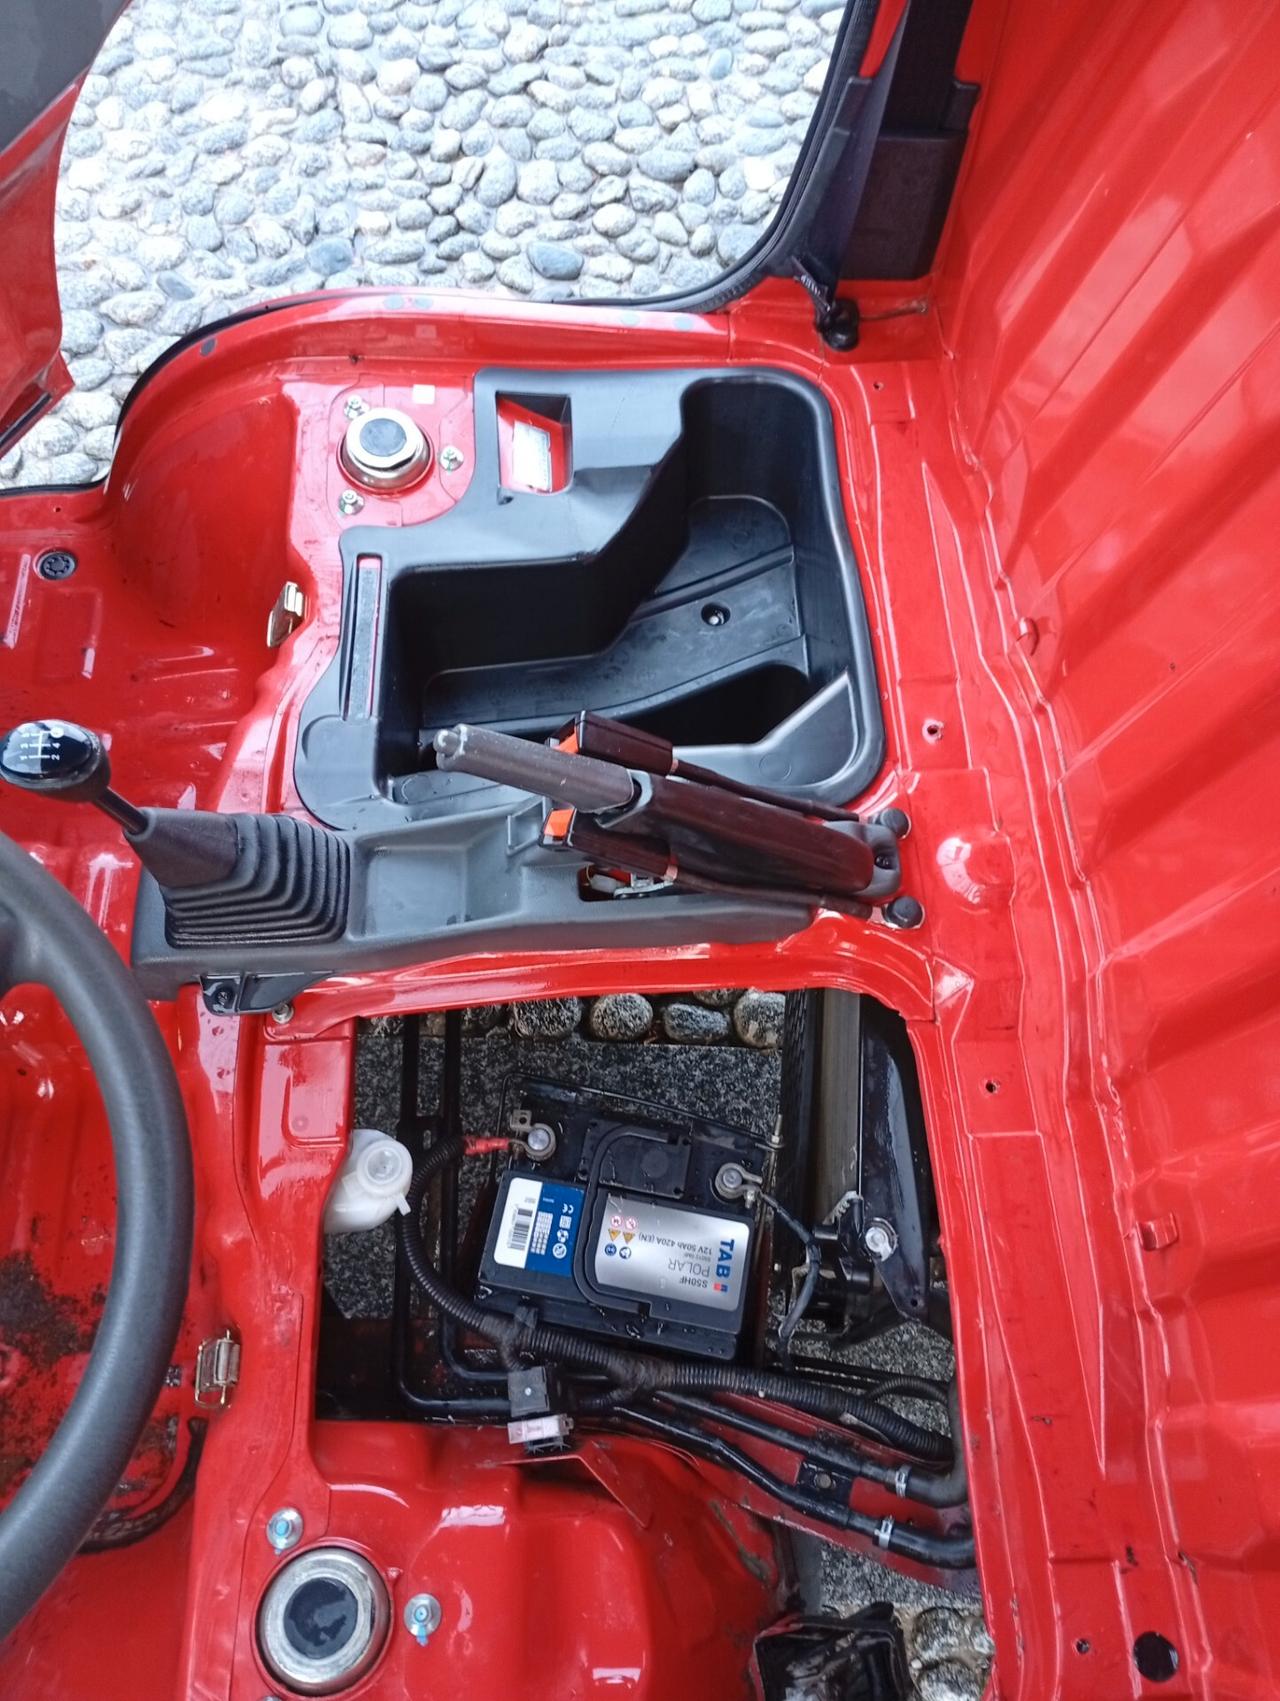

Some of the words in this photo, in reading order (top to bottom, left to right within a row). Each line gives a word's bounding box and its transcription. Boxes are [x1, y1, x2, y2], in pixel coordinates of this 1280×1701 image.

[638, 1232, 656, 1243] (EN)
[656, 1237, 676, 1247] 420A
[676, 1241, 698, 1253] 50Ah
[699, 1247, 712, 1255] 12V
[716, 1239, 735, 1279] TAB
[668, 1258, 711, 1277] POLAR
[680, 1277, 708, 1289] S50HF
